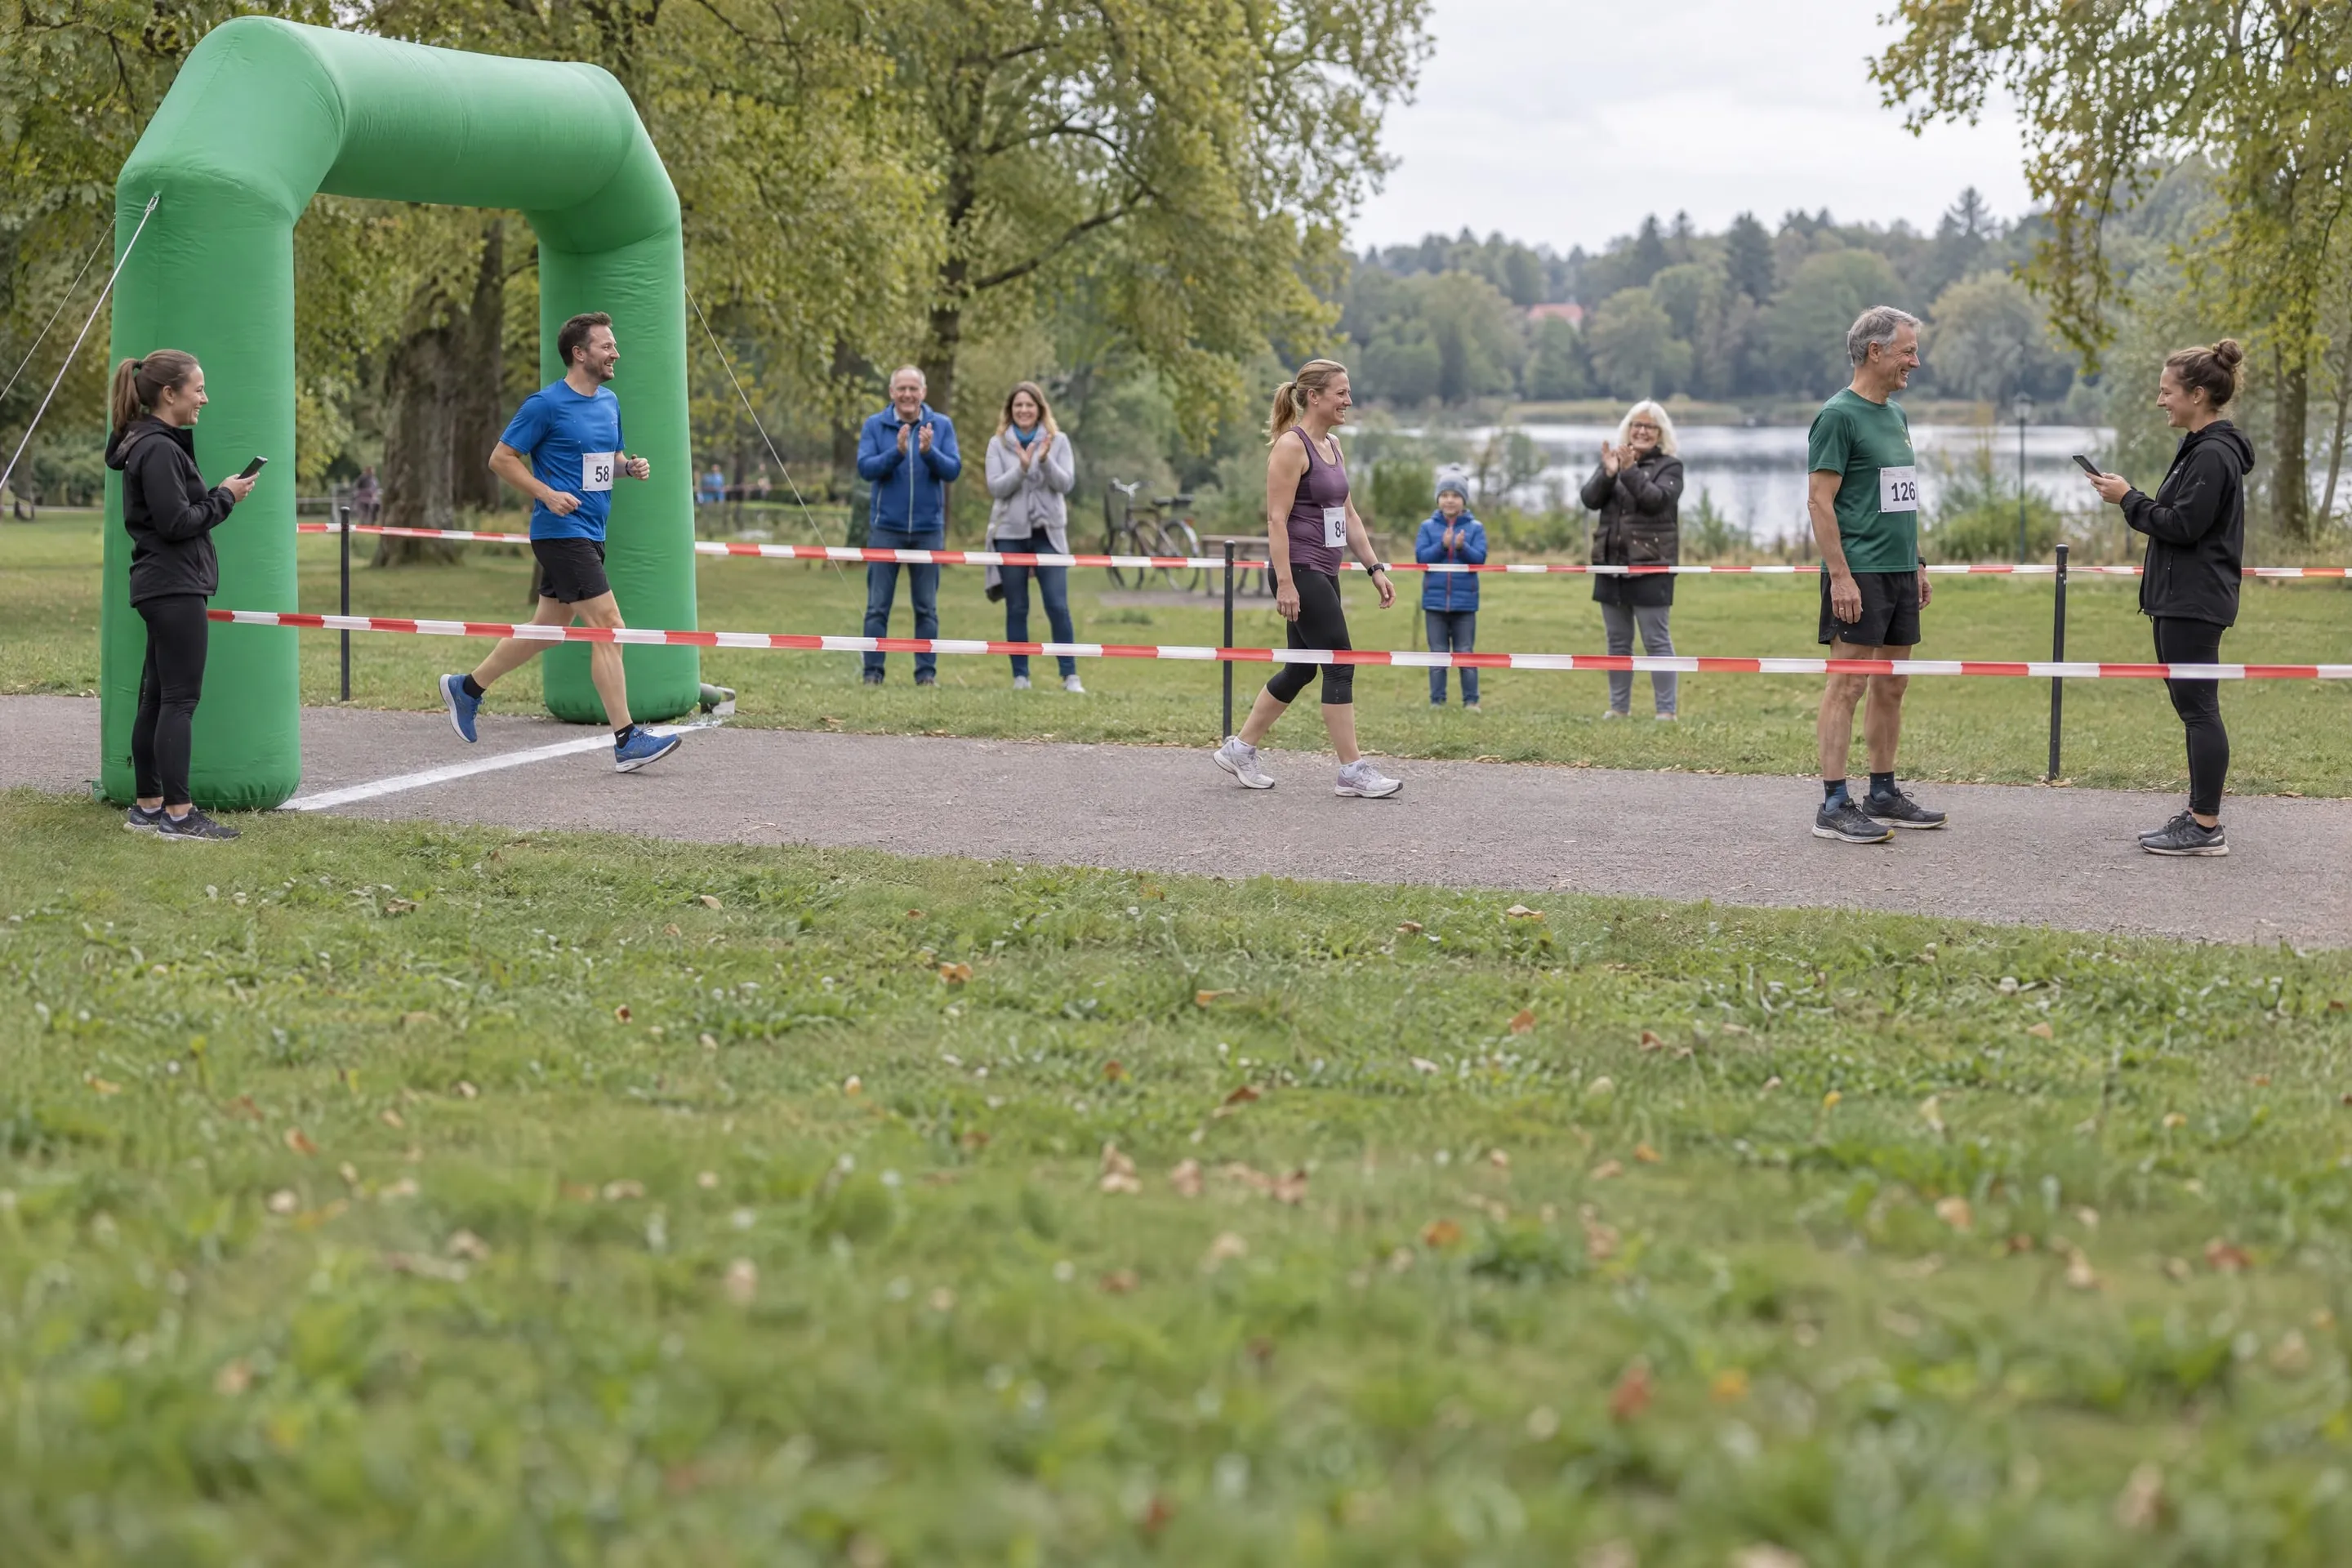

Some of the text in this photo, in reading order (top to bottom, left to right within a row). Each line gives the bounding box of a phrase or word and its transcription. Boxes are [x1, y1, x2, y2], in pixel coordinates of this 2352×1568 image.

[595, 466, 609, 483] 58
[1891, 481, 1916, 501] 126
[1334, 520, 1345, 538] 84
